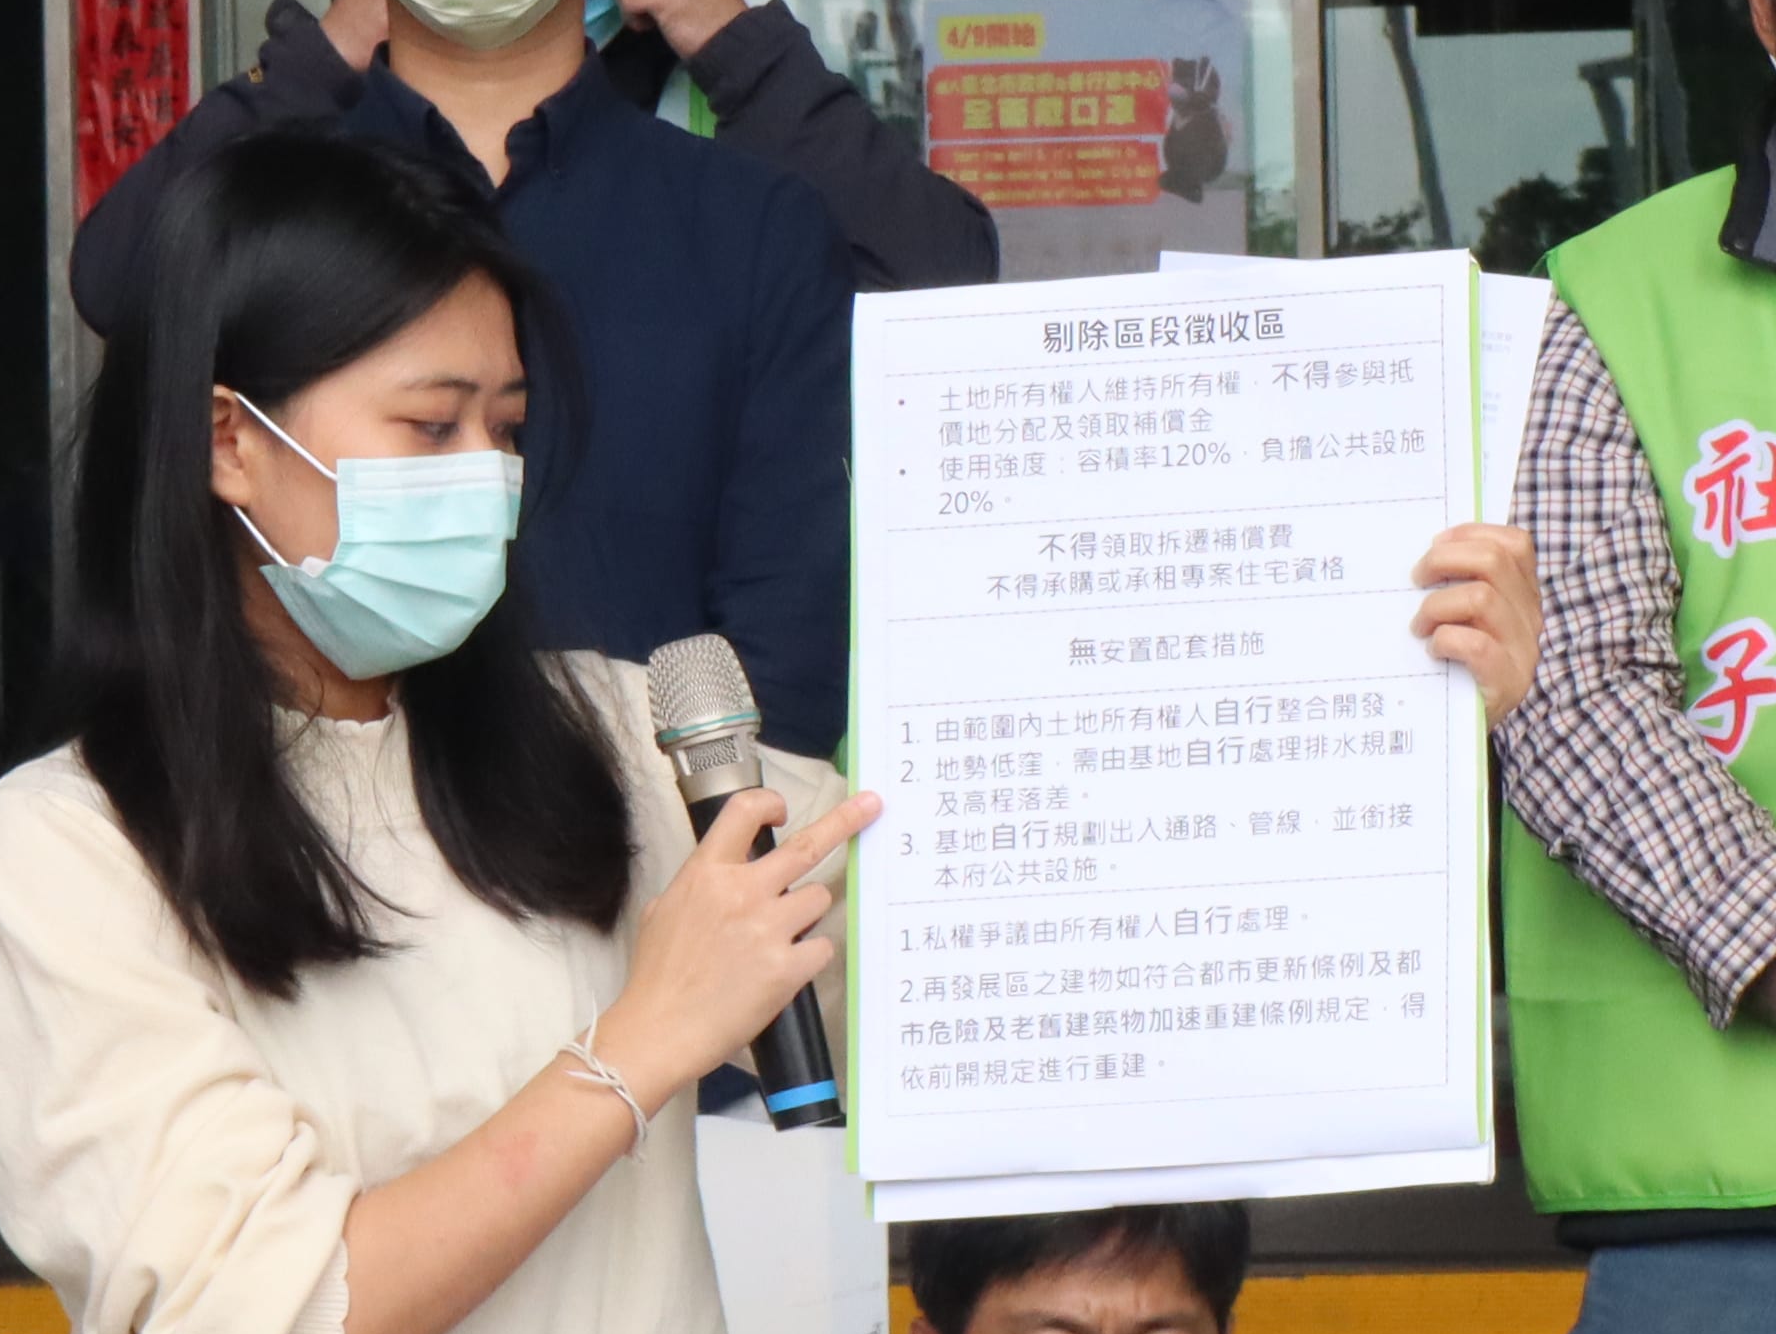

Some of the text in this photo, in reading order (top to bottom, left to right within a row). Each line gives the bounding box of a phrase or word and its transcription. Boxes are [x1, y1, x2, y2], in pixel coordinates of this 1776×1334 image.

[1042, 307, 1285, 352] 剔除區段徵收區
[938, 405, 1213, 448] 價地分配及領取補償金
[1038, 524, 1294, 562] 不得領取拆遷補償費
[986, 556, 1344, 600] 不得承購或承租專案住宅資格
[1069, 630, 1265, 667] 無安置配套措施
[935, 856, 1119, 889] 本府公共設施。
[900, 1051, 1167, 1092] 依前開規定進行重建。
